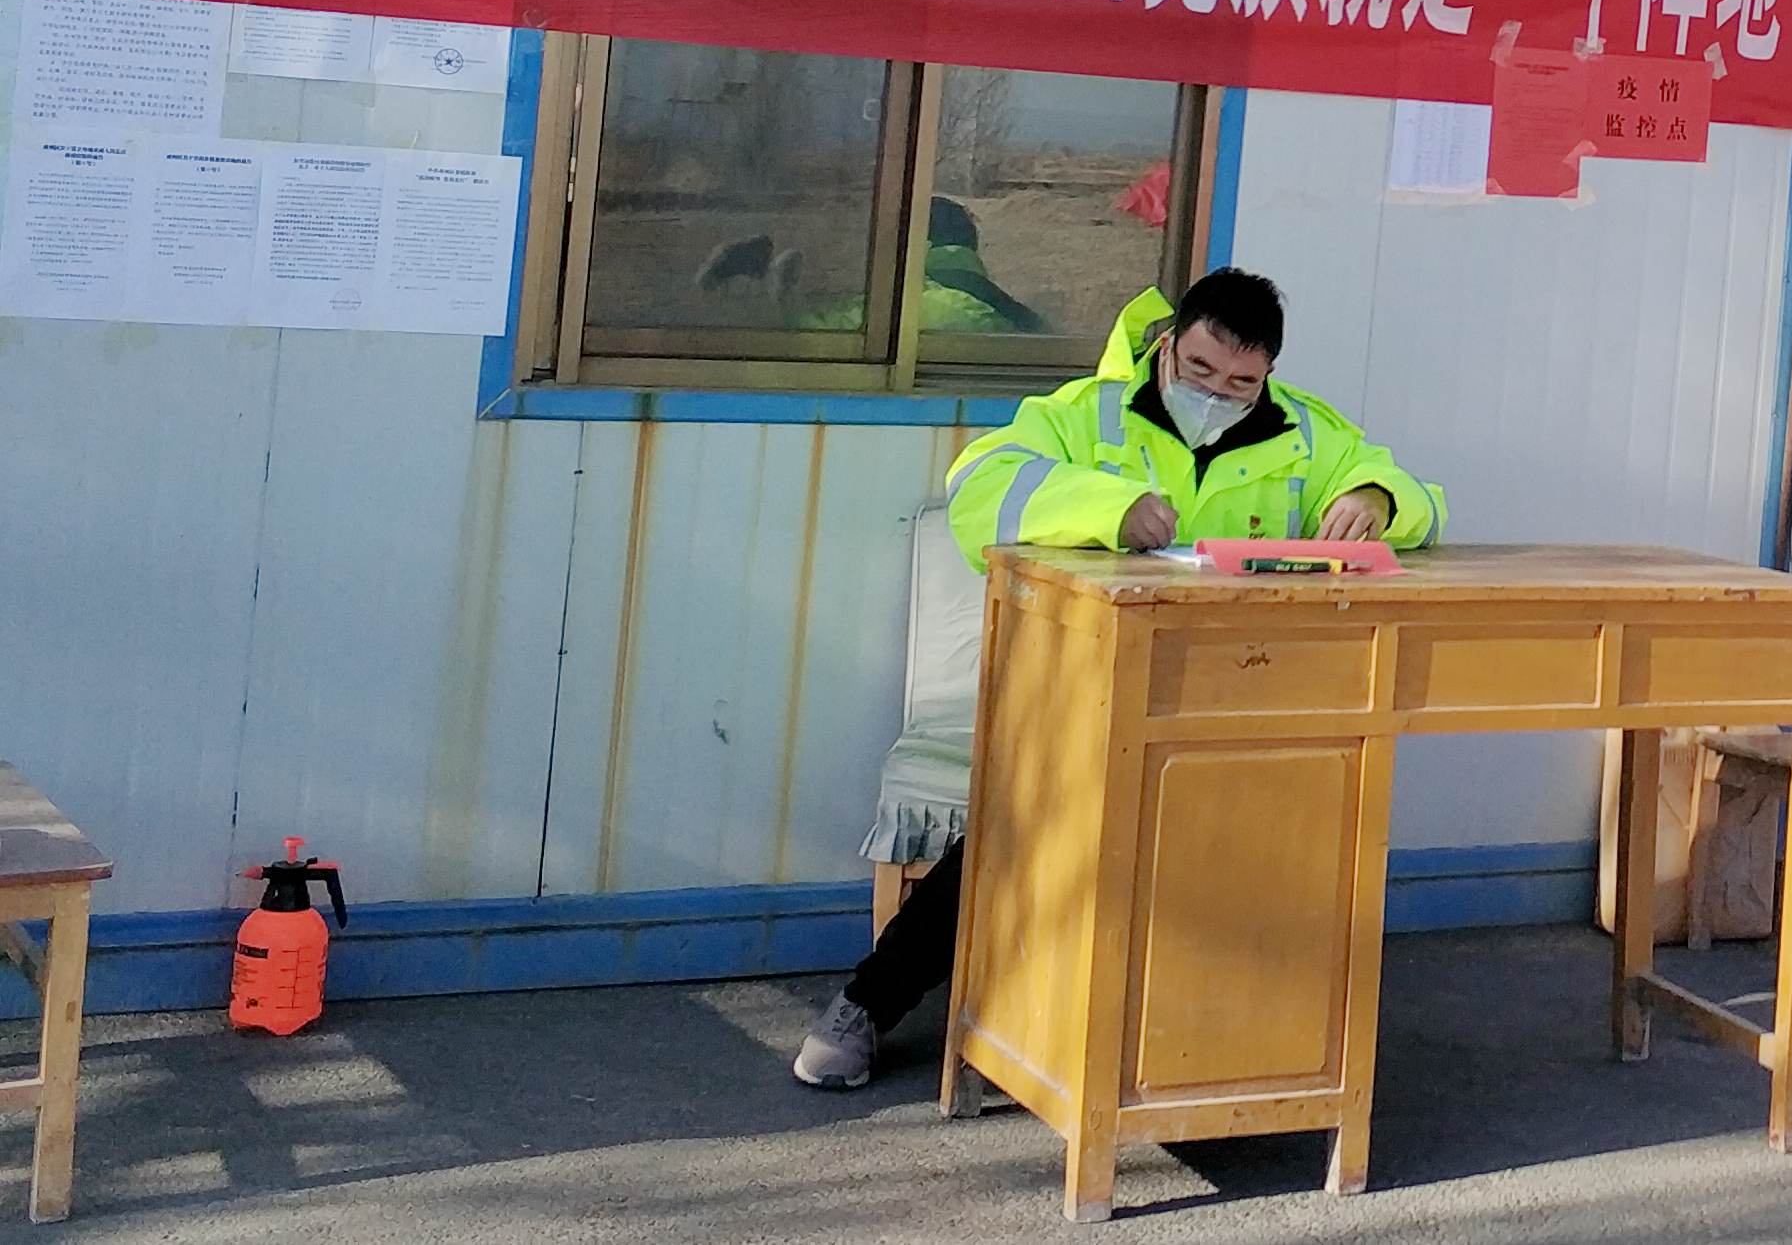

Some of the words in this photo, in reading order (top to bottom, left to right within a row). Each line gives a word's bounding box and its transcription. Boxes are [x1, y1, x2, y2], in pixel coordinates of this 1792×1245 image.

[1617, 75, 1680, 102] 疫情
[1605, 113, 1687, 141] 监控点
